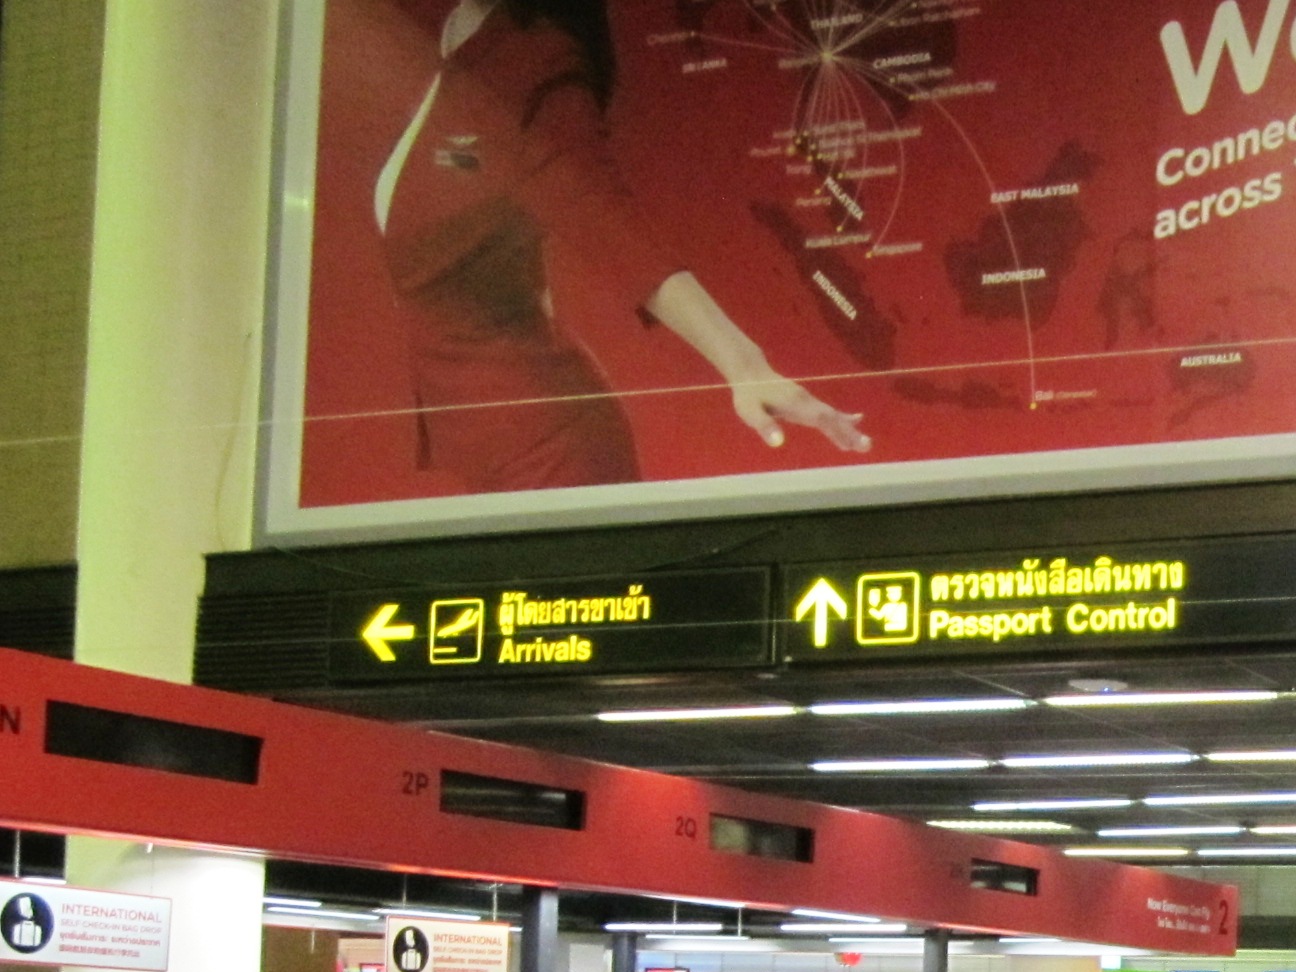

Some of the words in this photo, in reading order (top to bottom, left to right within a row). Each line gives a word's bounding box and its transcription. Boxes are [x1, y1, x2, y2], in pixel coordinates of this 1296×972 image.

[873, 52, 931, 69] CAMBODIA
[1020, 183, 1079, 199] MALAYSIA
[1154, 172, 1282, 239] across
[981, 267, 1046, 286] INDONESIA
[812, 269, 857, 320] INDONESIA
[1180, 352, 1242, 367] AUSTRALIA
[930, 556, 1184, 602] ตรวจหนังสือเดินทาง
[498, 585, 650, 636] ผู้โดยสารขาเข้า
[929, 606, 1052, 642] Passport
[1067, 597, 1178, 633] Control
[498, 635, 591, 664] Arrivals
[402, 770, 429, 796] 2P
[675, 815, 697, 841] 2Q
[61, 903, 162, 923] INTERNATIONAL
[1219, 899, 1229, 935] 2
[433, 933, 502, 946] INTERNATIONAL
